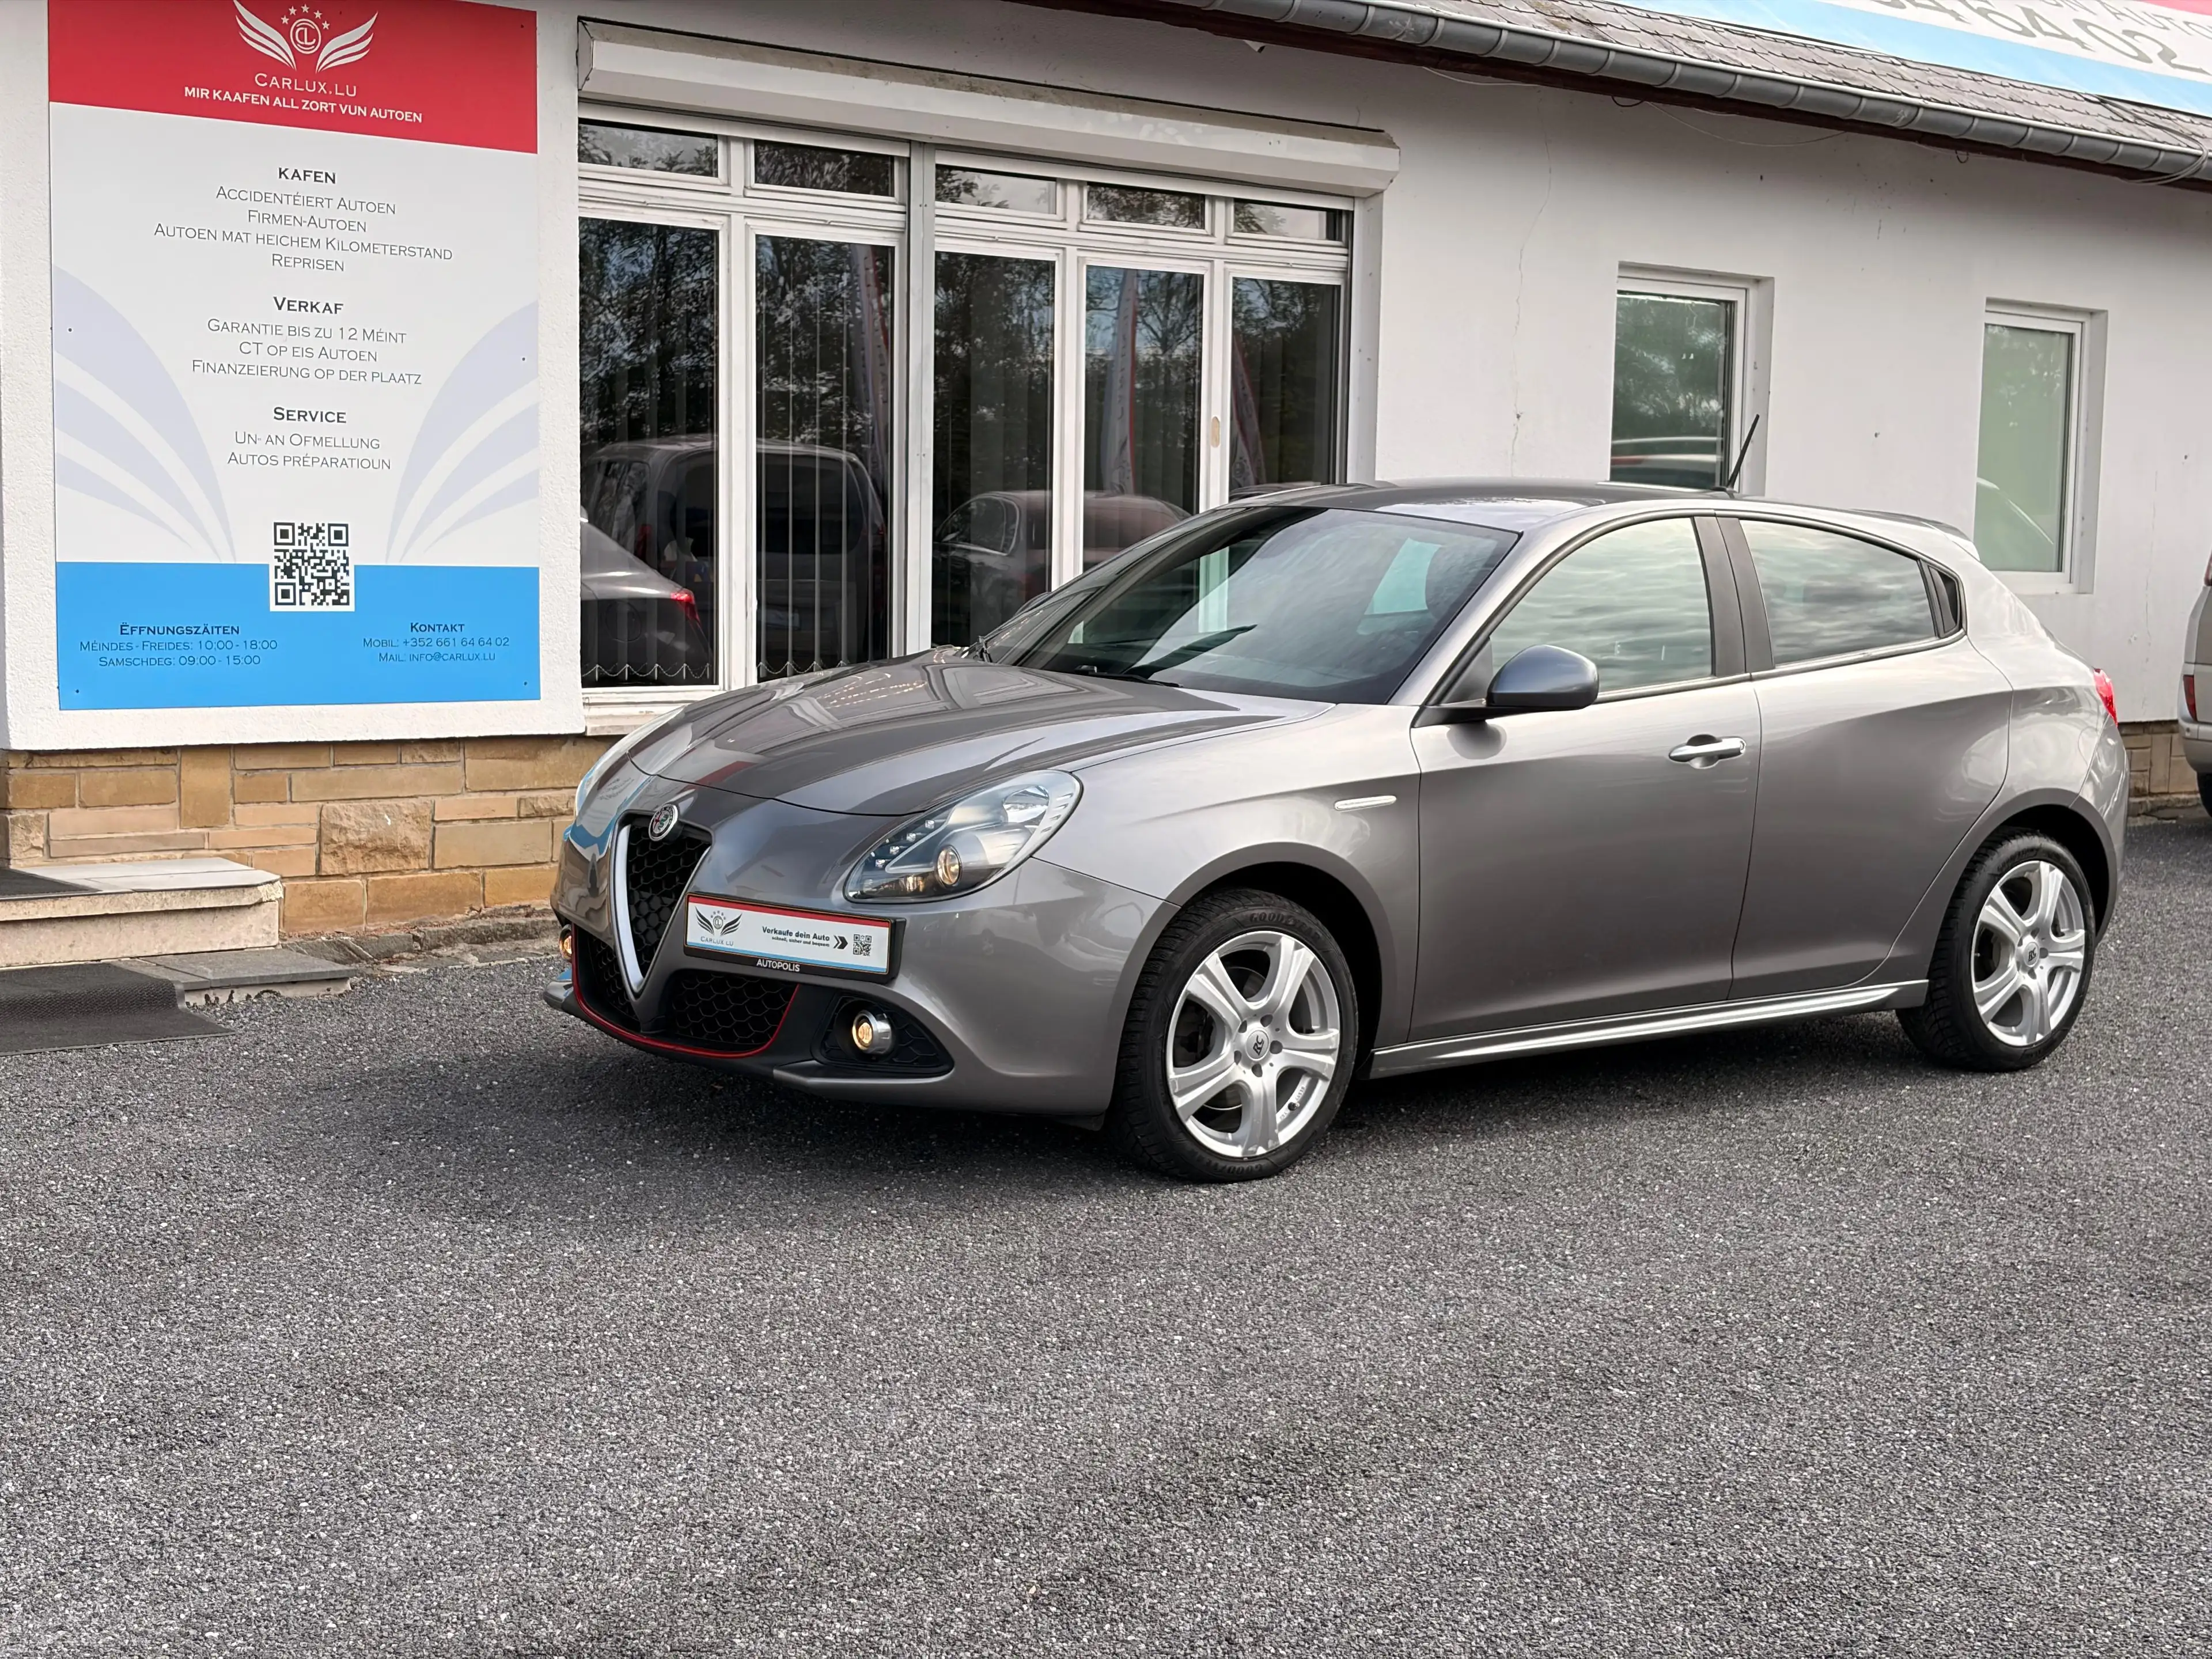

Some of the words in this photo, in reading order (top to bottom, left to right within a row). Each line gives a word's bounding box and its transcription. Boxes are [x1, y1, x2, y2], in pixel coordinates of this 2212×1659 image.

[2099, 0, 2212, 40] AUTO
[2073, 18, 2211, 75] 02
[255, 73, 357, 97] CARLUX.LU
[184, 86, 210, 99] MIR
[213, 89, 270, 106] KAAFEN
[272, 96, 300, 109] ALL
[301, 99, 337, 113] ZORT
[338, 103, 367, 117] VUN
[369, 107, 422, 123] AUTOEN
[278, 167, 336, 184] KAFEN
[215, 186, 334, 209] ACCIDENTÉIERT
[336, 197, 396, 215] AUTOEN
[248, 209, 366, 233] FIRMEN-AUTOEN
[154, 223, 217, 241] AUTOEN
[222, 230, 252, 244] MAT
[256, 233, 321, 249] HEICHEM
[272, 253, 344, 272] REPRISEN
[273, 296, 344, 315] VERKAF
[207, 318, 283, 336] GARANTIE
[287, 325, 310, 338] BIS
[314, 327, 332, 339] ZU
[362, 328, 407, 344] MÉINT
[239, 341, 263, 355] CT
[267, 344, 288, 357] OP
[292, 346, 315, 358] EIS
[317, 346, 377, 362] AUTOEN
[192, 359, 310, 378] FINANZEIERUNG
[314, 368, 335, 380] OP
[339, 369, 367, 382] DER
[372, 371, 422, 385] PLAATZ
[273, 406, 347, 423] SERVICE
[264, 434, 285, 446] AN
[289, 433, 380, 449] OFMELLUNG
[227, 452, 279, 466] AUTOS
[283, 453, 391, 470] PRÉPARATIOUN
[120, 622, 240, 635] ËFFNUNGSZÄITEN
[410, 622, 465, 633] KONTAKT
[199, 639, 234, 651] 10:00
[243, 639, 278, 650] 18:00
[403, 637, 433, 647] +352
[435, 637, 456, 647] 661
[460, 637, 475, 647] 64
[478, 637, 492, 647] 64
[495, 637, 509, 647] 02
[179, 655, 216, 666] 09:00
[226, 655, 261, 665] 15:00
[762, 926, 793, 937] Verkaufe
[795, 931, 810, 939] dein
[812, 933, 830, 941] Auto
[756, 959, 800, 972] AUTOPOLIS
